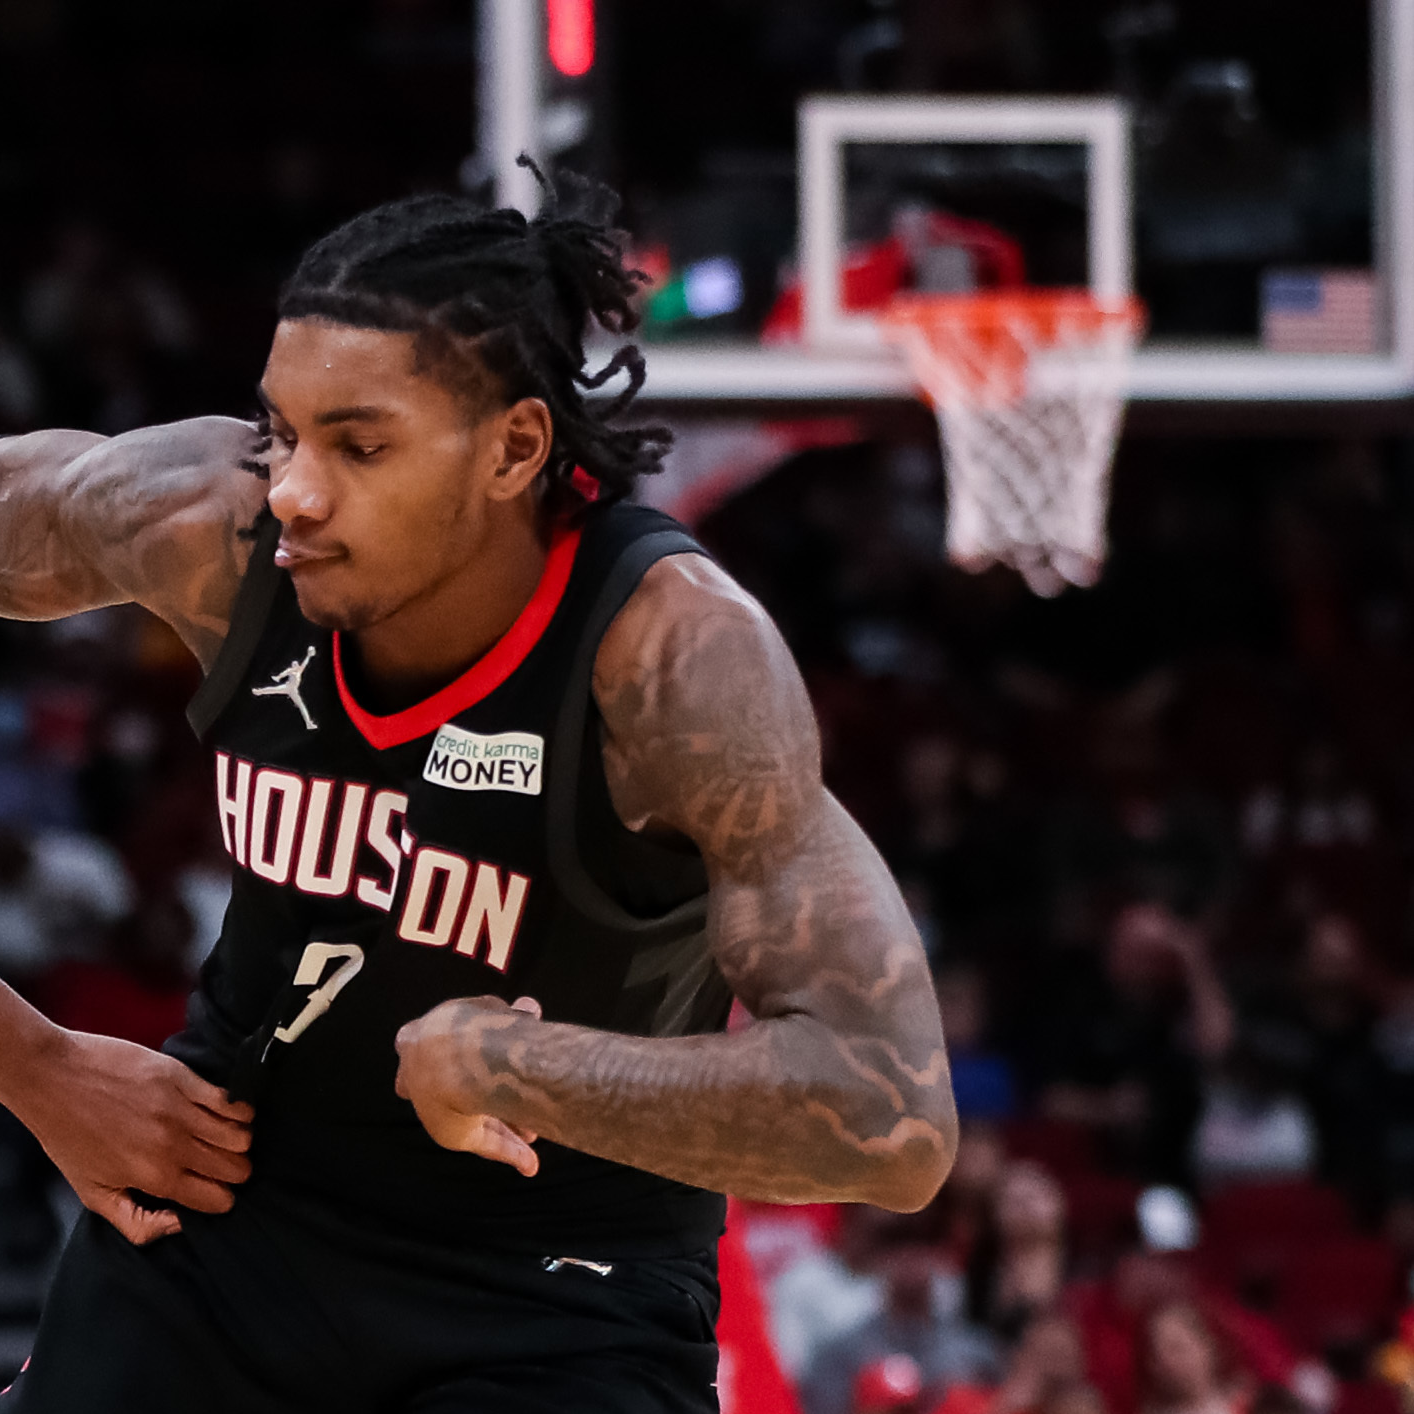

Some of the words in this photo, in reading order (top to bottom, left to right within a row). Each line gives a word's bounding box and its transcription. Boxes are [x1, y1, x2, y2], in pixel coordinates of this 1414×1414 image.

[435, 734, 479, 759] credit
[483, 742, 539, 760] karma
[427, 750, 537, 788] MONEY
[215, 751, 532, 974] HOUSON
